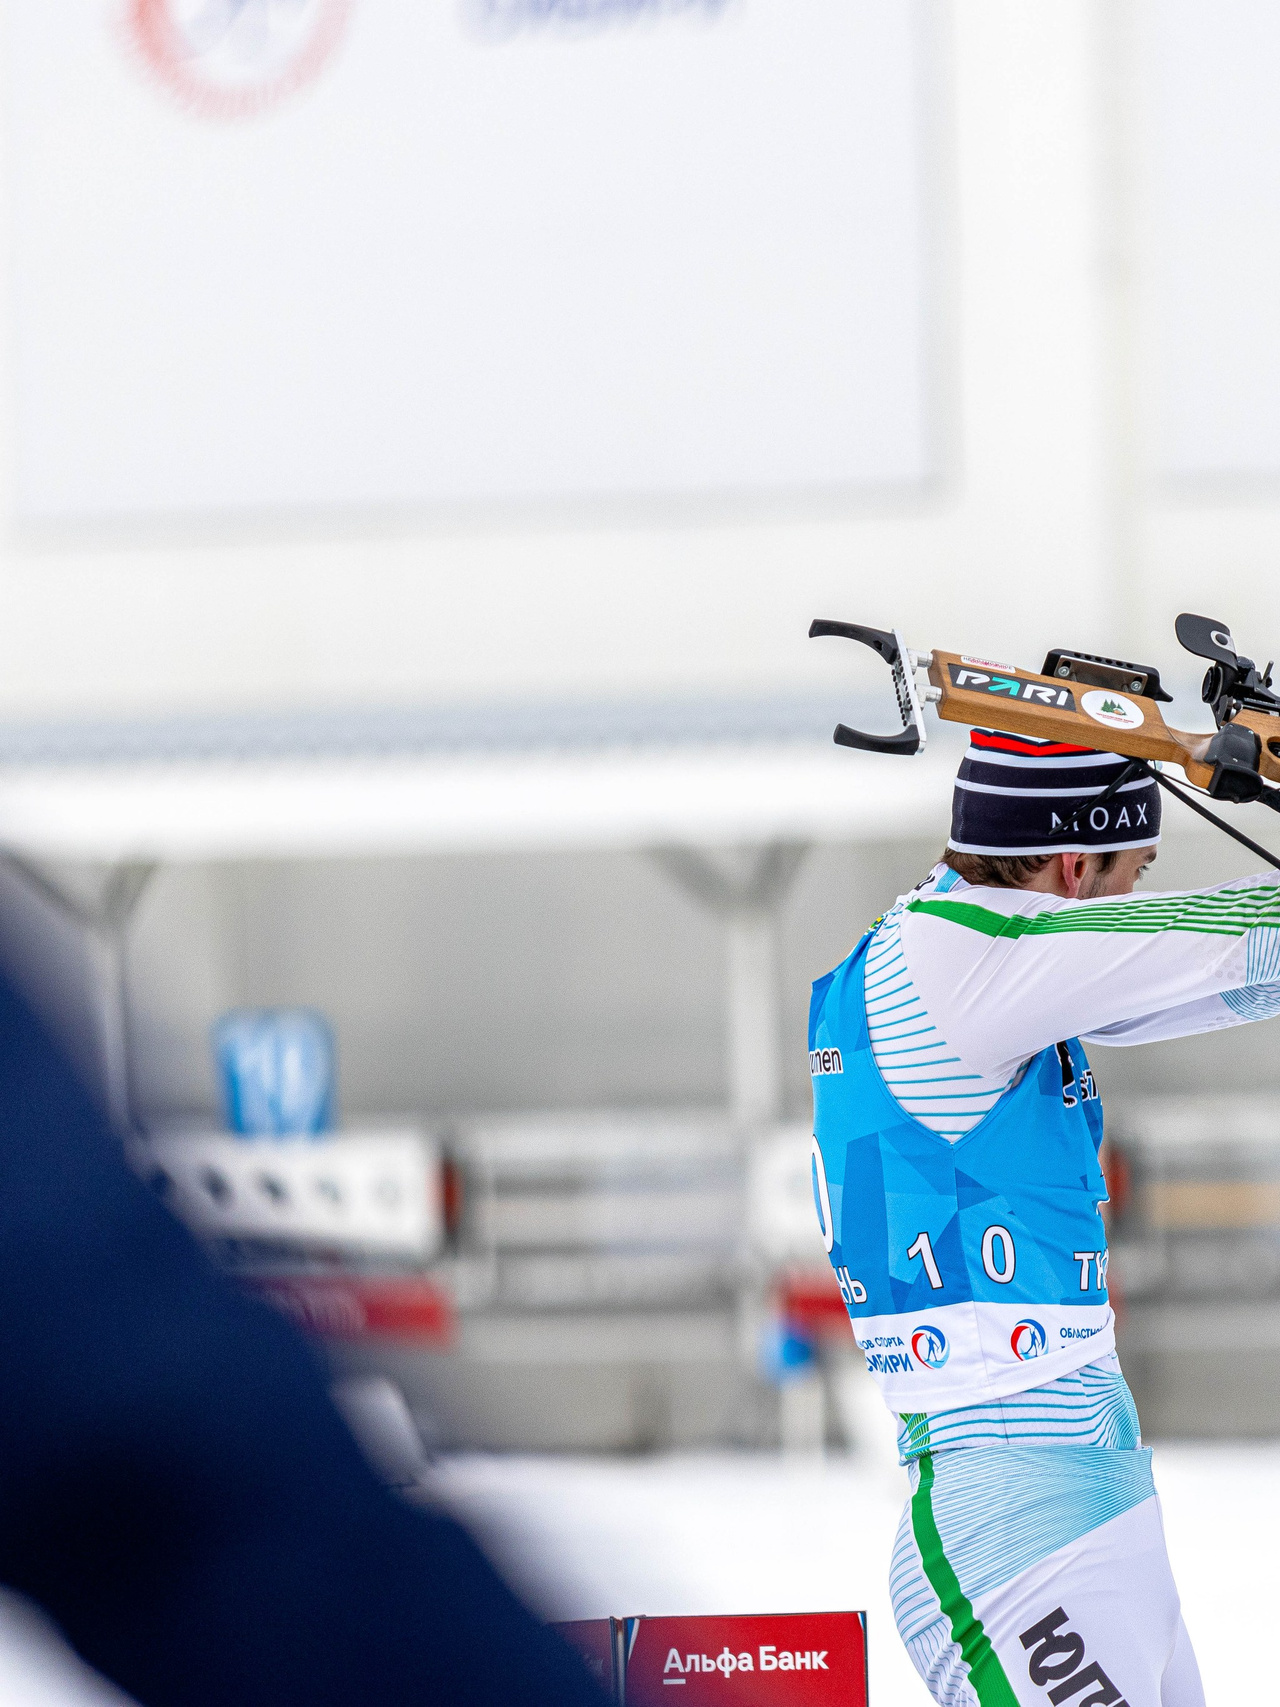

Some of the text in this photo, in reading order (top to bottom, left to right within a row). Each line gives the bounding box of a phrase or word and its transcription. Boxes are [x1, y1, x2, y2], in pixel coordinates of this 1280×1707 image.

[956, 670, 1069, 706] PARI
[663, 1645, 830, 1680] Альфа Банк
